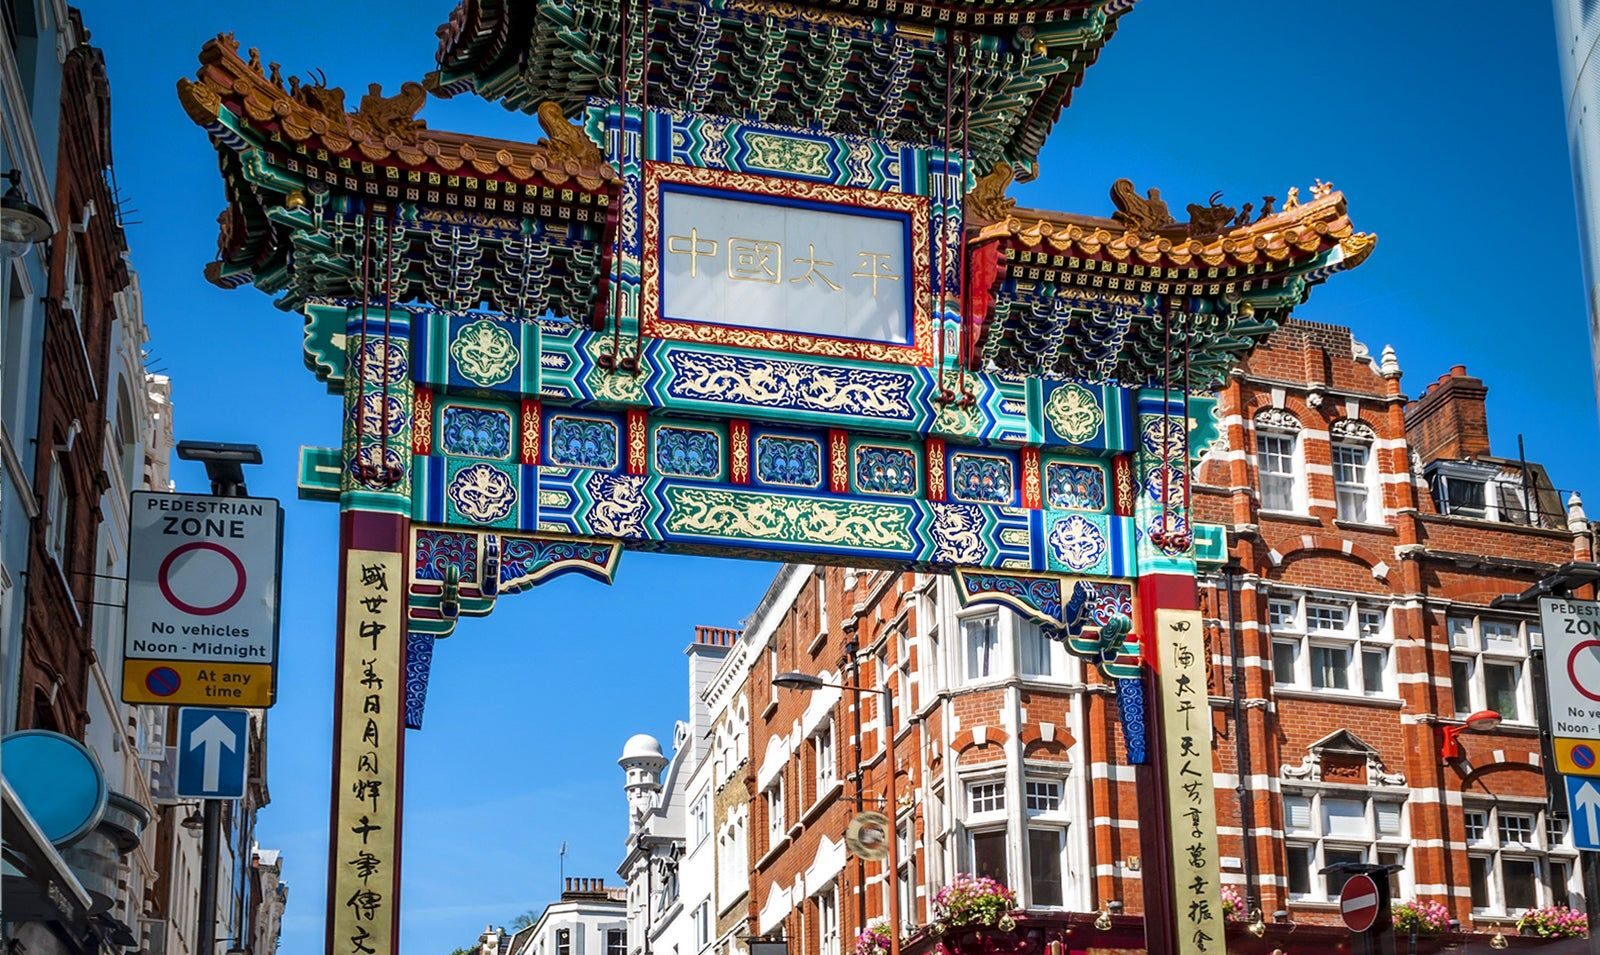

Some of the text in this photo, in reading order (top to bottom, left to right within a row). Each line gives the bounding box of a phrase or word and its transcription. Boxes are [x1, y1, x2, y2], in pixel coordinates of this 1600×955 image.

[668, 227, 900, 298] 中國太平
[148, 498, 263, 516] PEDESTRIAN
[163, 516, 245, 539] ZONE
[1551, 603, 1600, 616] PEDEST
[151, 621, 250, 638] No vehicles
[133, 640, 178, 653] Noon
[192, 642, 266, 658] Midnight
[197, 669, 252, 685] At any
[205, 685, 242, 698] time
[1567, 706, 1585, 718] No
[1557, 721, 1589, 733] Noon
